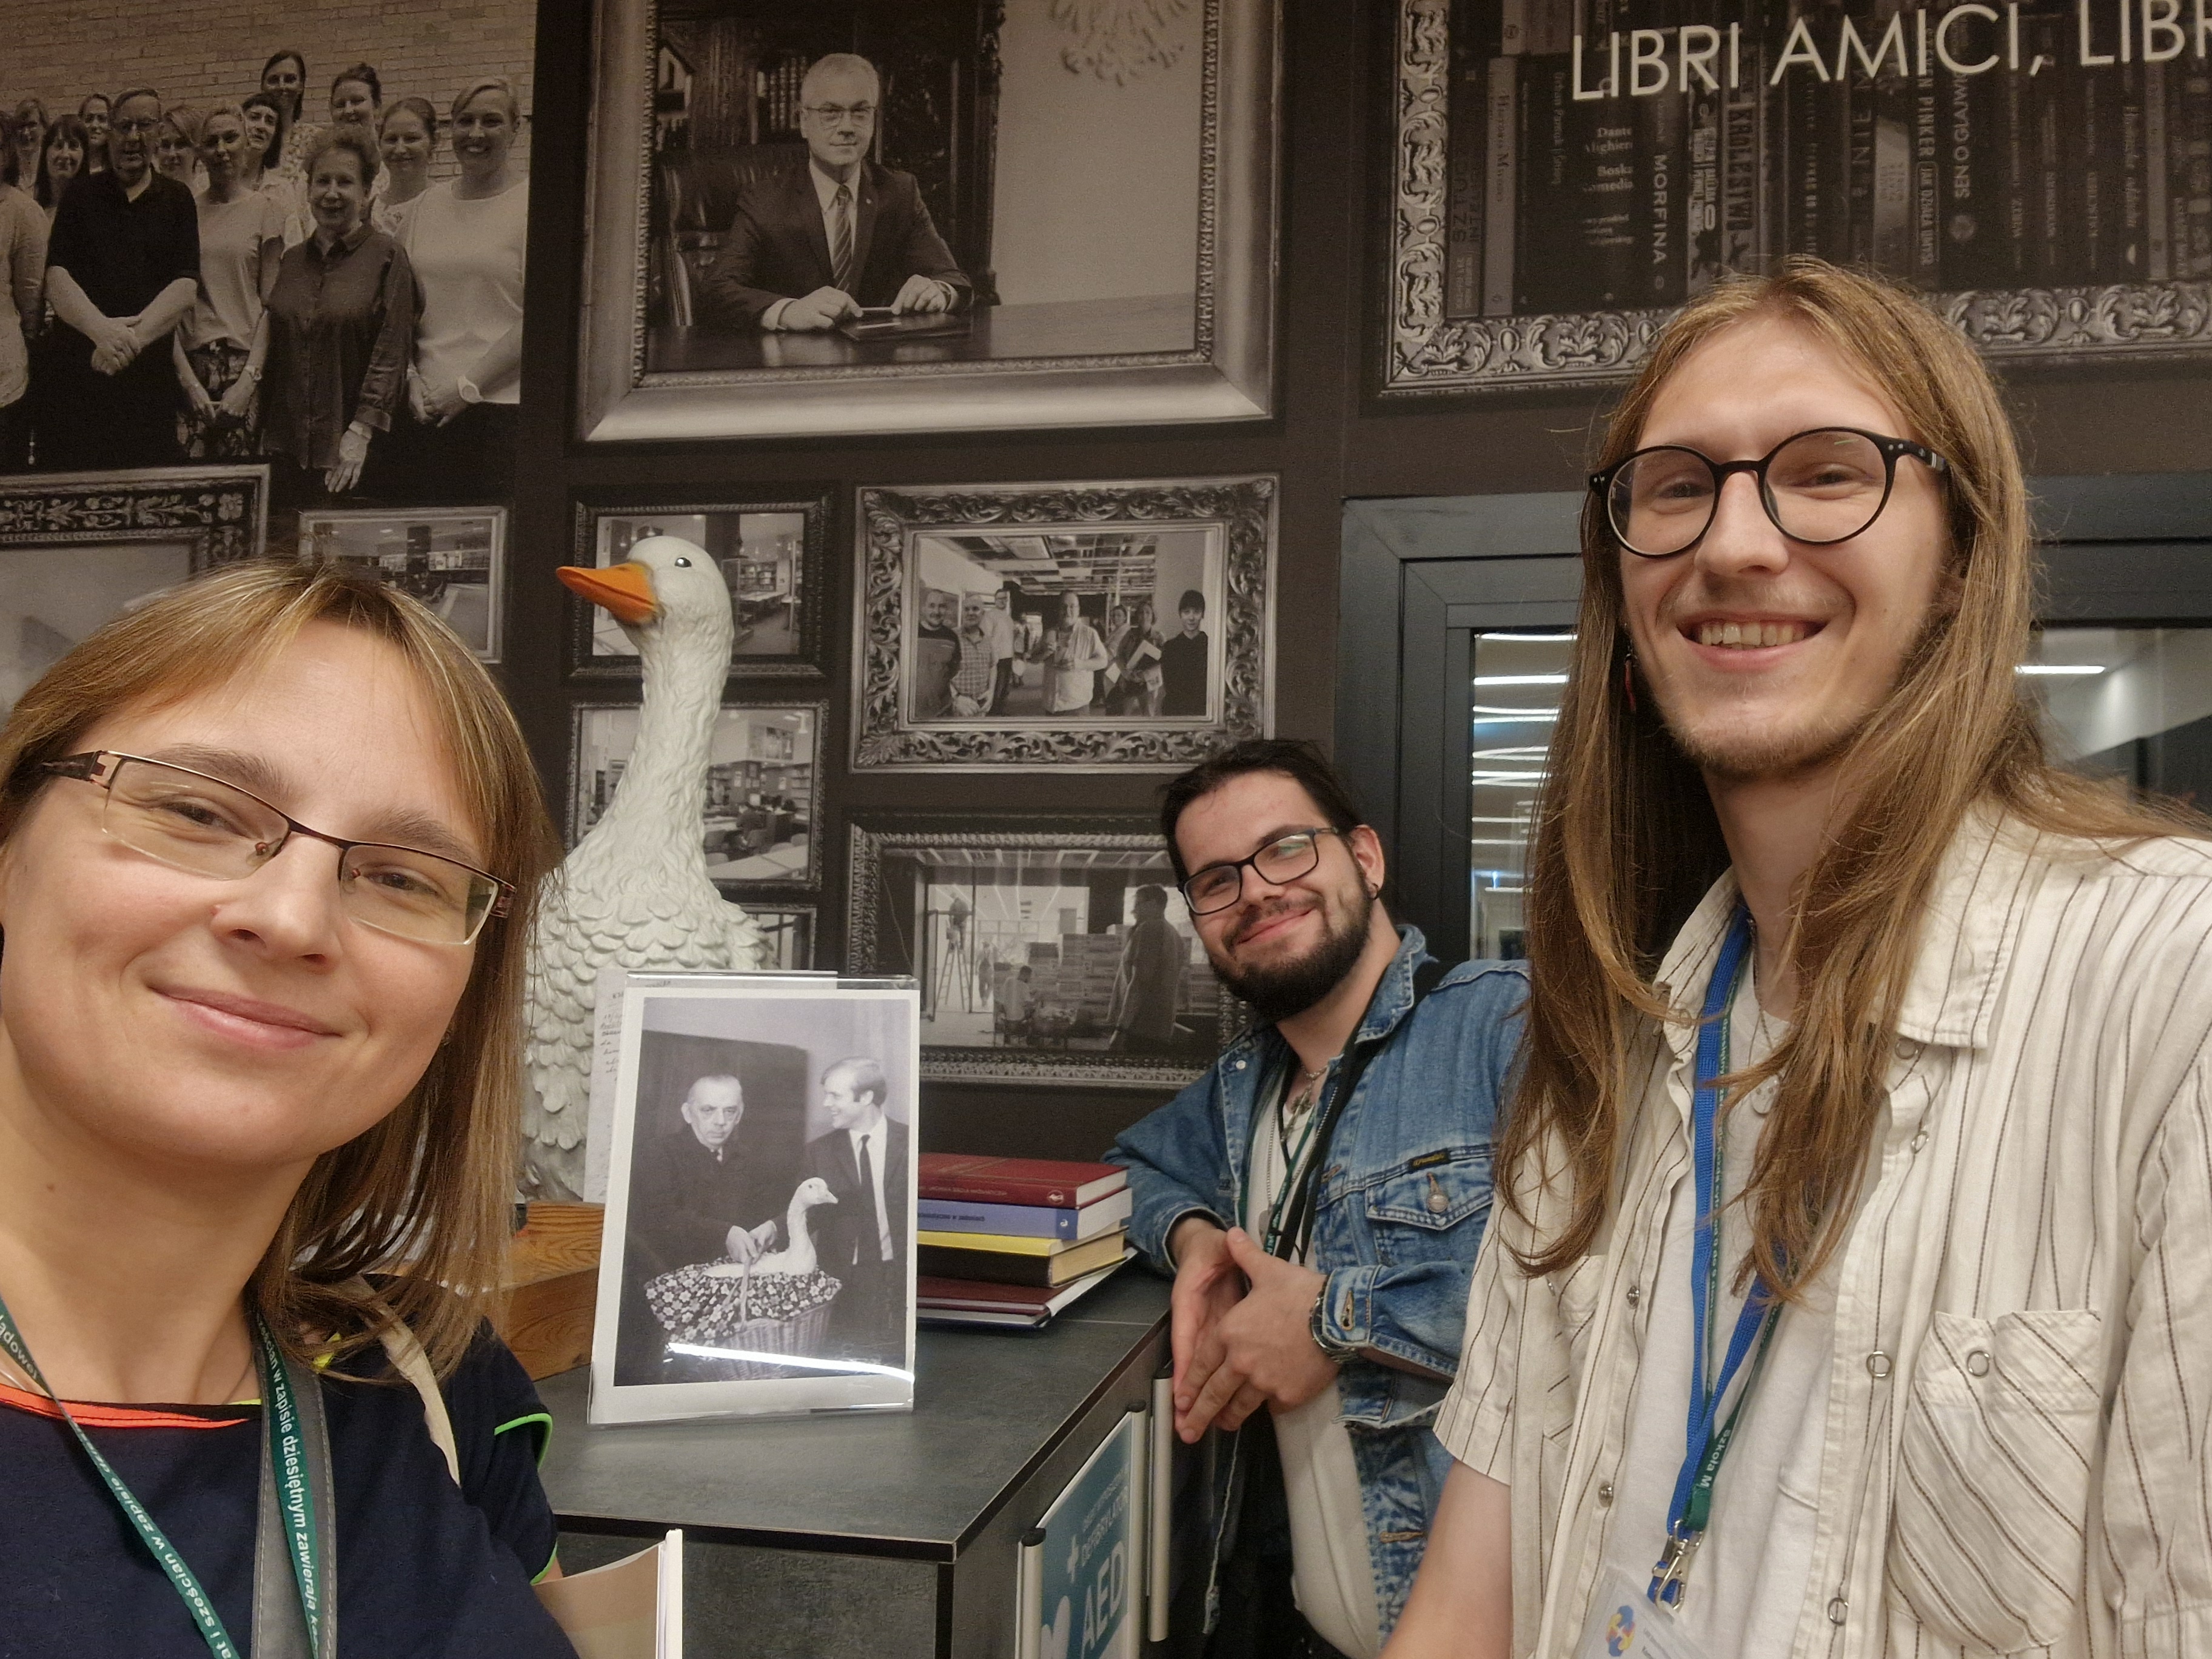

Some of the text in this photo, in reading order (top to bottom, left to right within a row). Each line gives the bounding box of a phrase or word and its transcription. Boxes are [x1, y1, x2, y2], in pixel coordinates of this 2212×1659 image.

[1572, 21, 1740, 101] LIBRI
[1769, 1, 2043, 85] AMICI,
[1653, 154, 1669, 264] MORFINA
[275, 1383, 295, 1433] zapisie
[282, 1435, 306, 1528] dziesiętnym
[1081, 1540, 1125, 1659] AED
